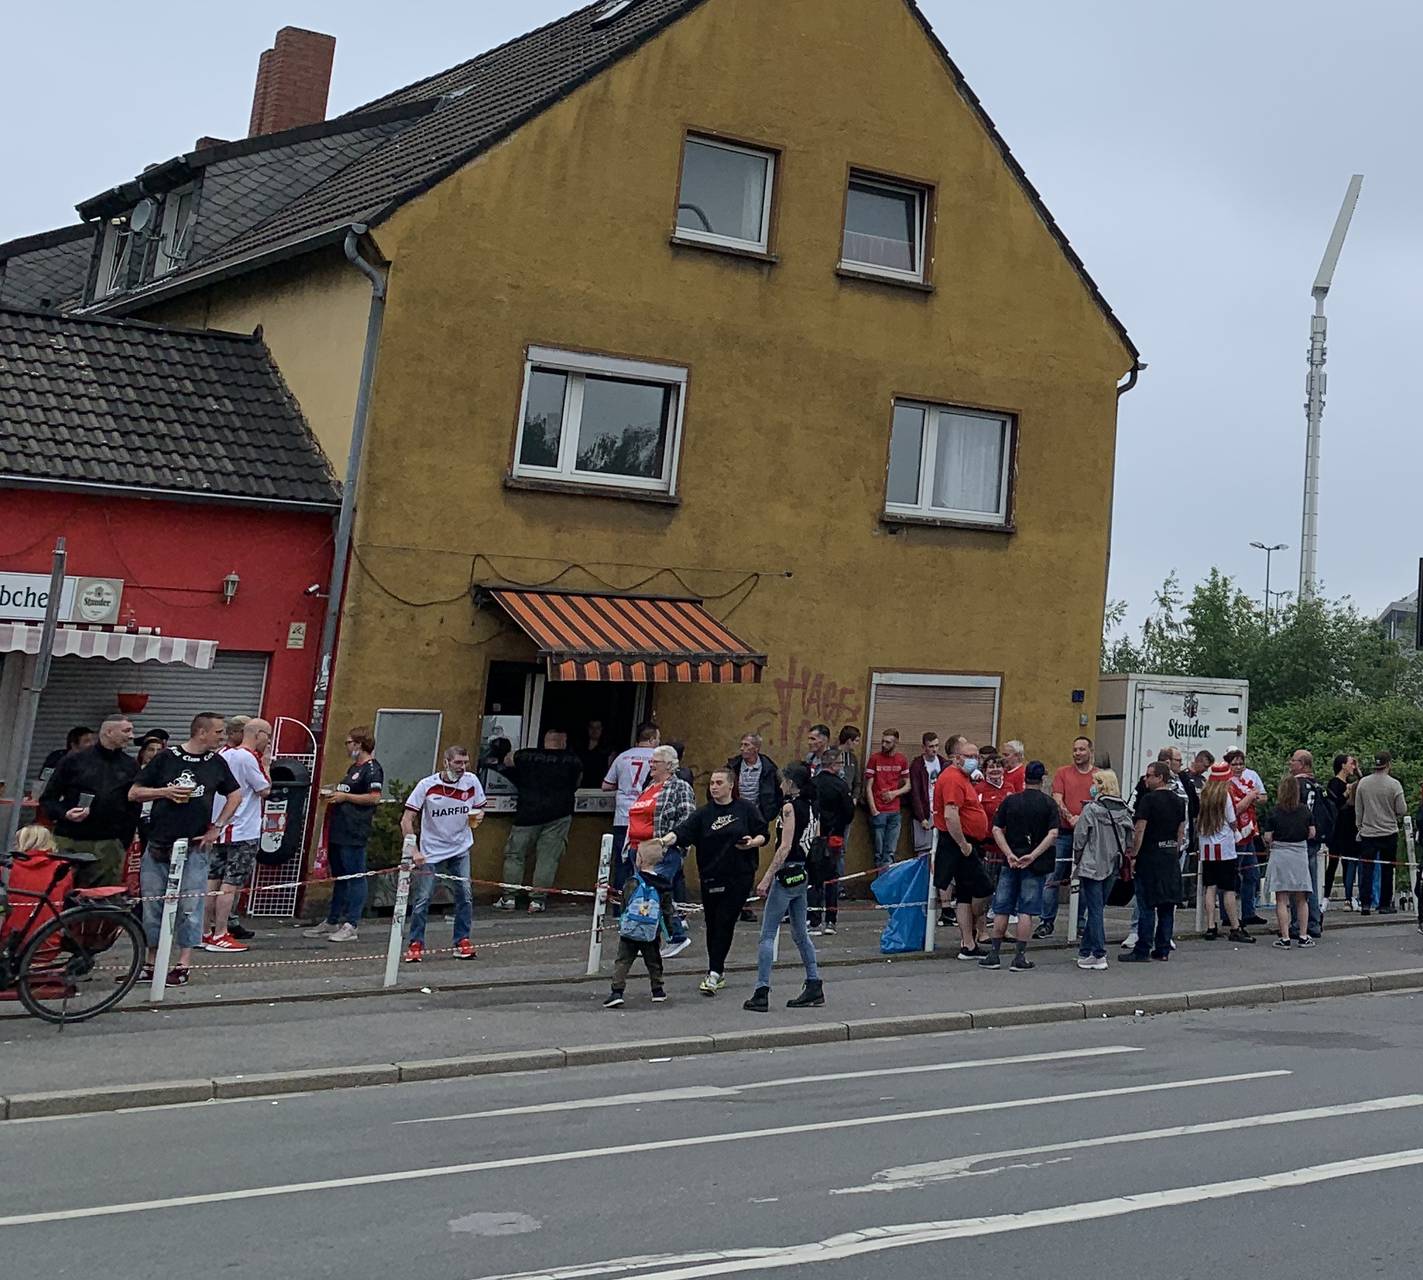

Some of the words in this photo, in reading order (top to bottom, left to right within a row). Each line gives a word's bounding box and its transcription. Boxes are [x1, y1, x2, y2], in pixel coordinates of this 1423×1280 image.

[0, 585, 49, 608] bche
[1168, 718, 1210, 739] Stauder
[631, 761, 643, 788] 7
